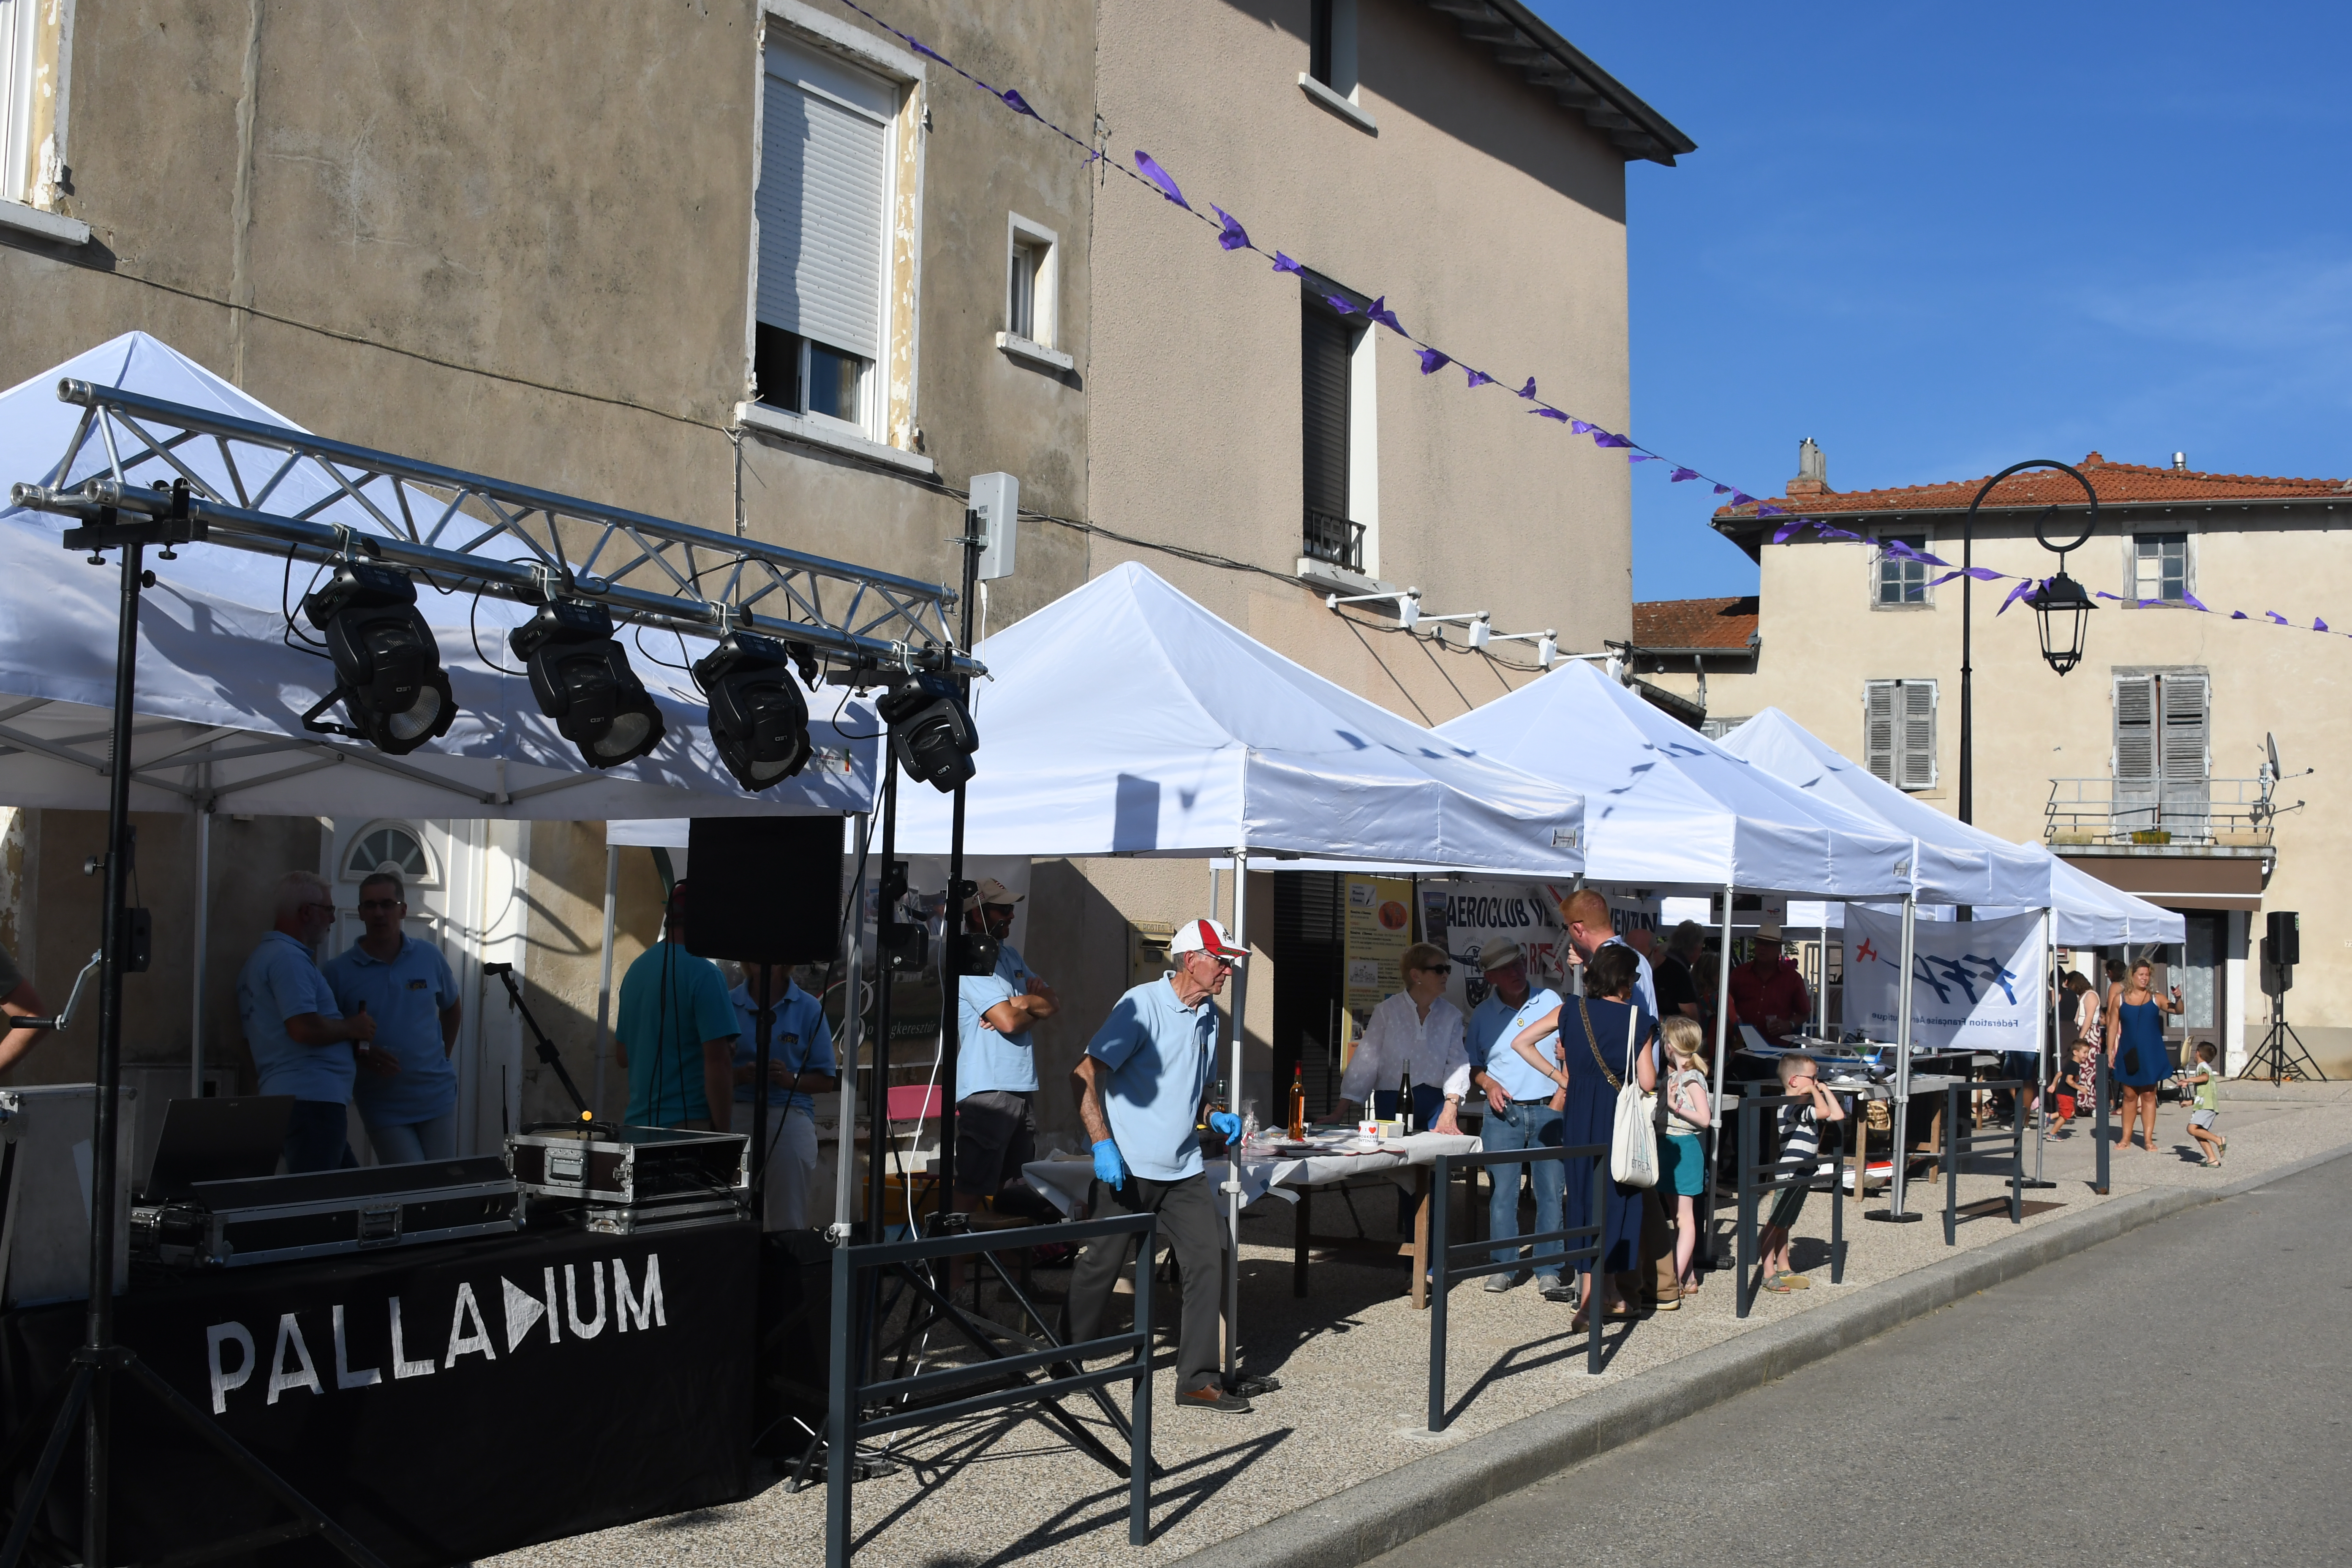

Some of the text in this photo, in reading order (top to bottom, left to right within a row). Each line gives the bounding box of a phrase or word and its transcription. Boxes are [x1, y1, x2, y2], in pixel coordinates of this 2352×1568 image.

[937, 765, 950, 774] LED
[1446, 895, 1530, 928] AEROCLUB
[1143, 923, 1165, 932] POSTES
[207, 1253, 667, 1415] PALLADIUM
